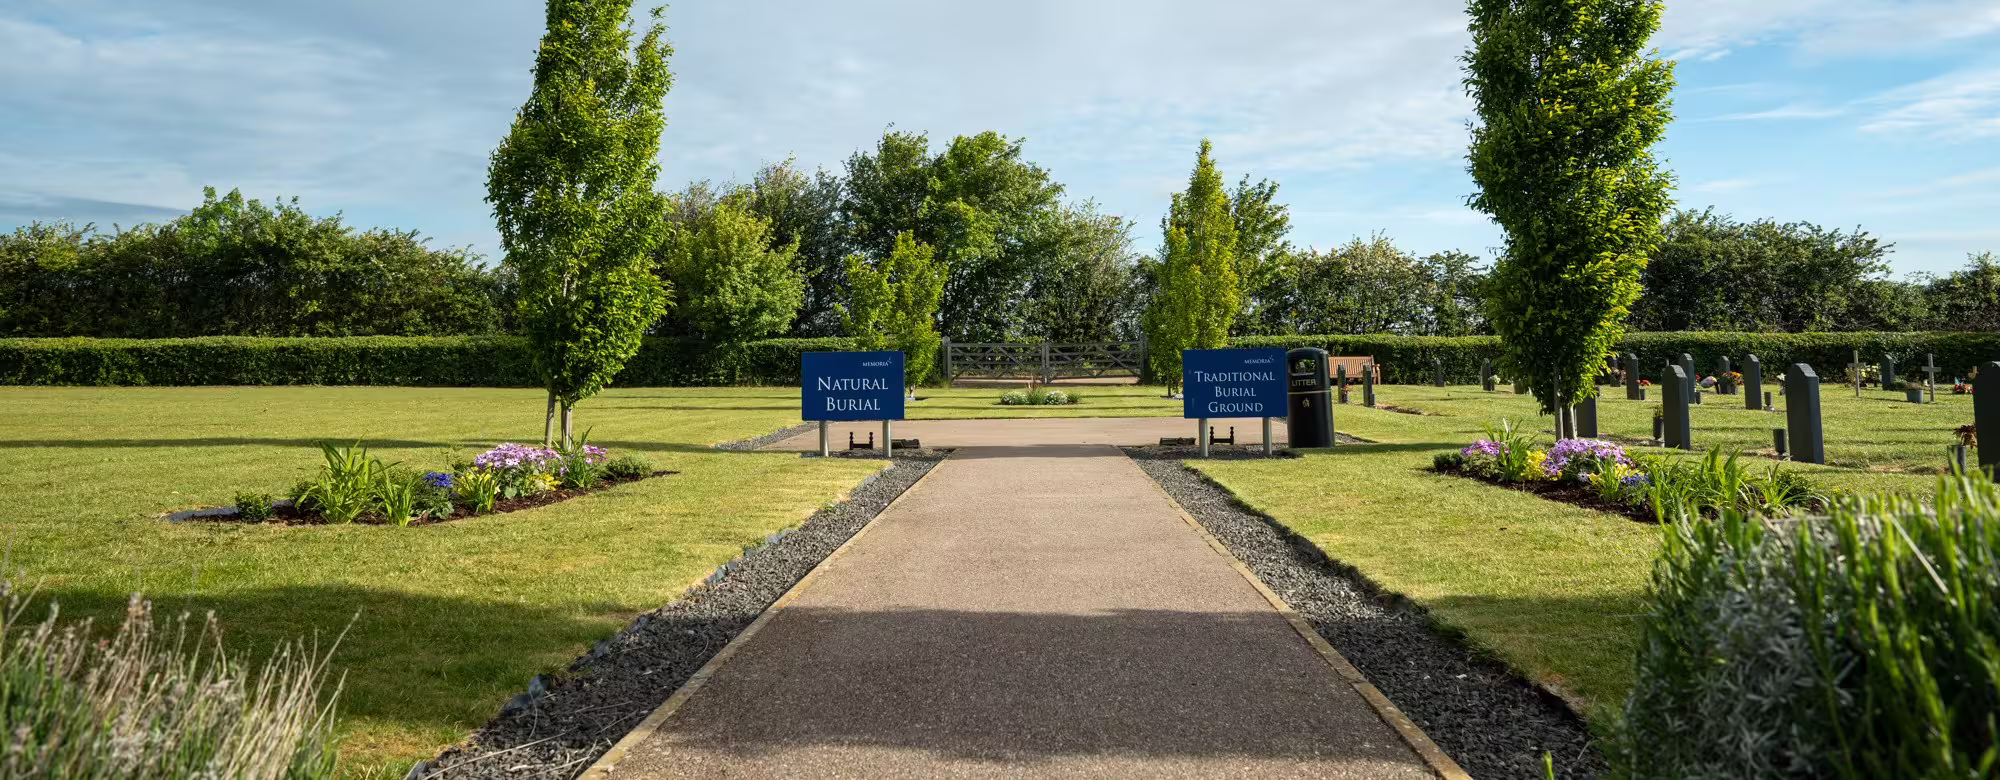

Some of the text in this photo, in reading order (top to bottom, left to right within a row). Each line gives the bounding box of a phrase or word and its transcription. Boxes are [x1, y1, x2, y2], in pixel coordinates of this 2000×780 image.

[1194, 371, 1275, 383] TRADITIONAL
[1291, 378, 1317, 387] LITTER
[817, 376, 889, 391] NATURAL
[1215, 386, 1256, 397] BURIAL
[826, 396, 881, 411] BURIAL
[1208, 401, 1263, 413] GROUND
